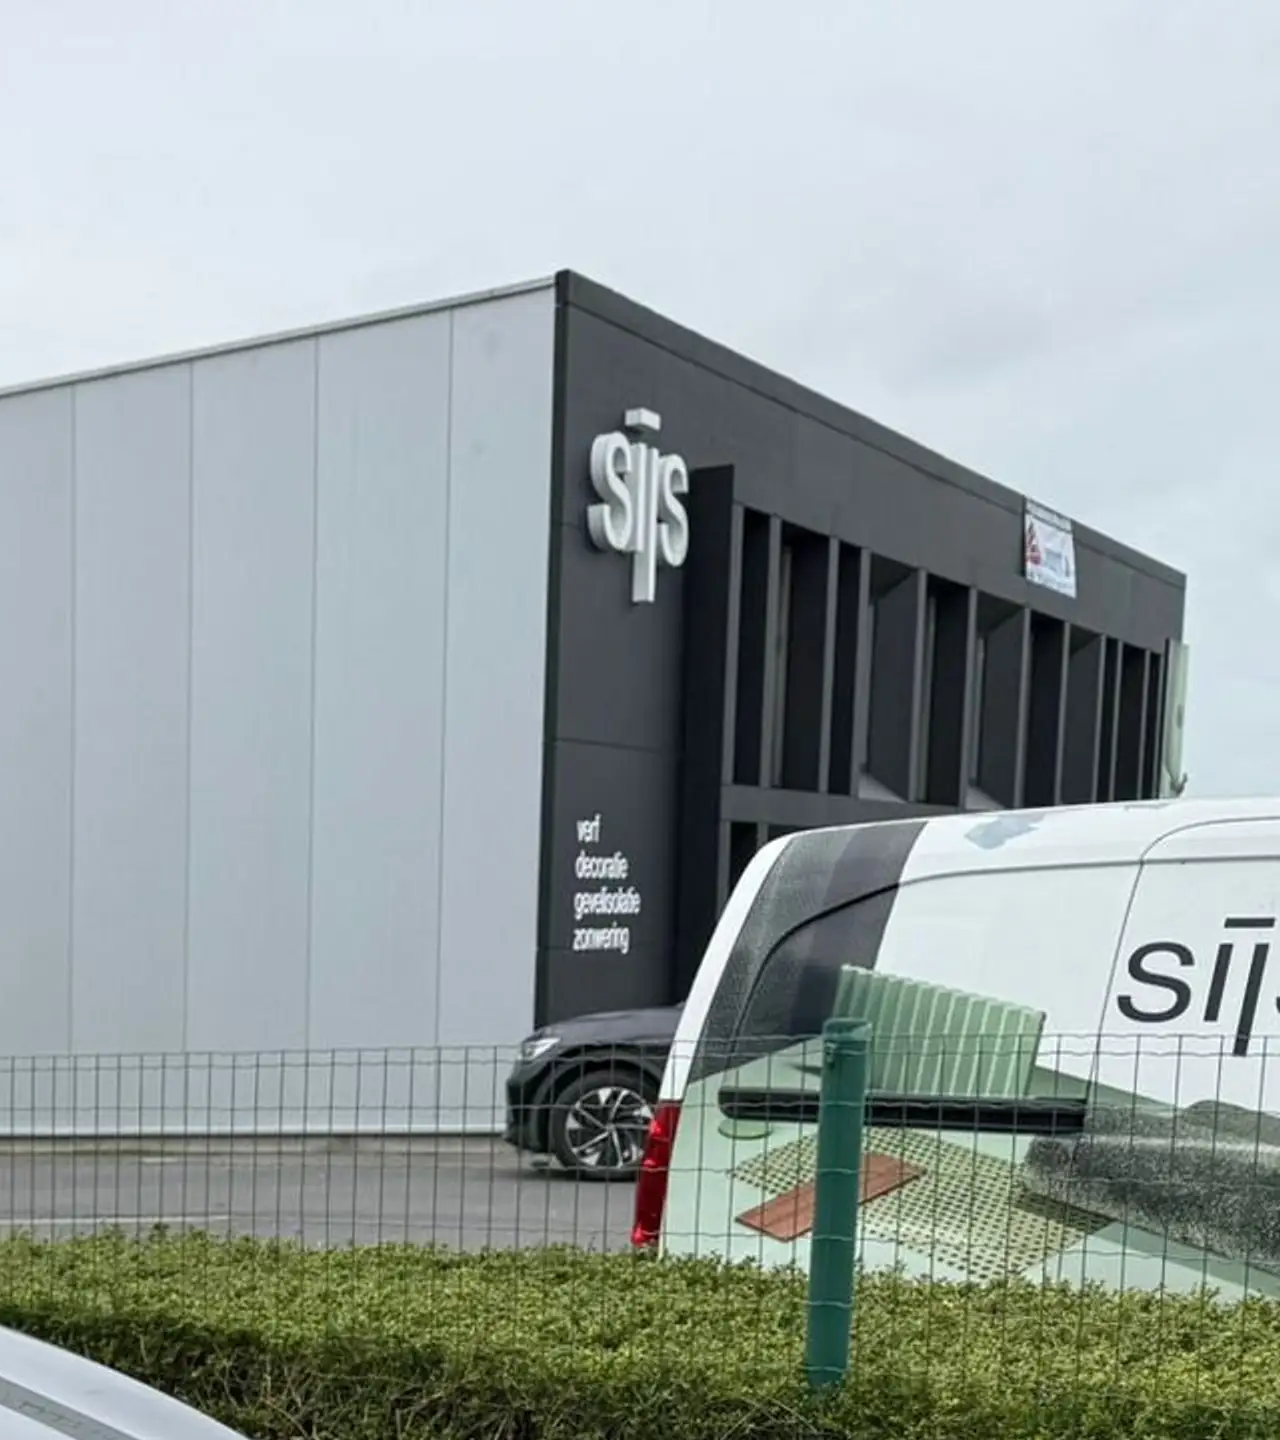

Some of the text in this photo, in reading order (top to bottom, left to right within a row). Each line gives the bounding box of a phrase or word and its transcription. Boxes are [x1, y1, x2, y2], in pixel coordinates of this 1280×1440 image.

[576, 813, 601, 842] verf
[575, 849, 628, 879] decoratie
[573, 886, 641, 920] gevelisolatie
[572, 921, 630, 955] zonwering
[1117, 917, 1280, 1057] sij
